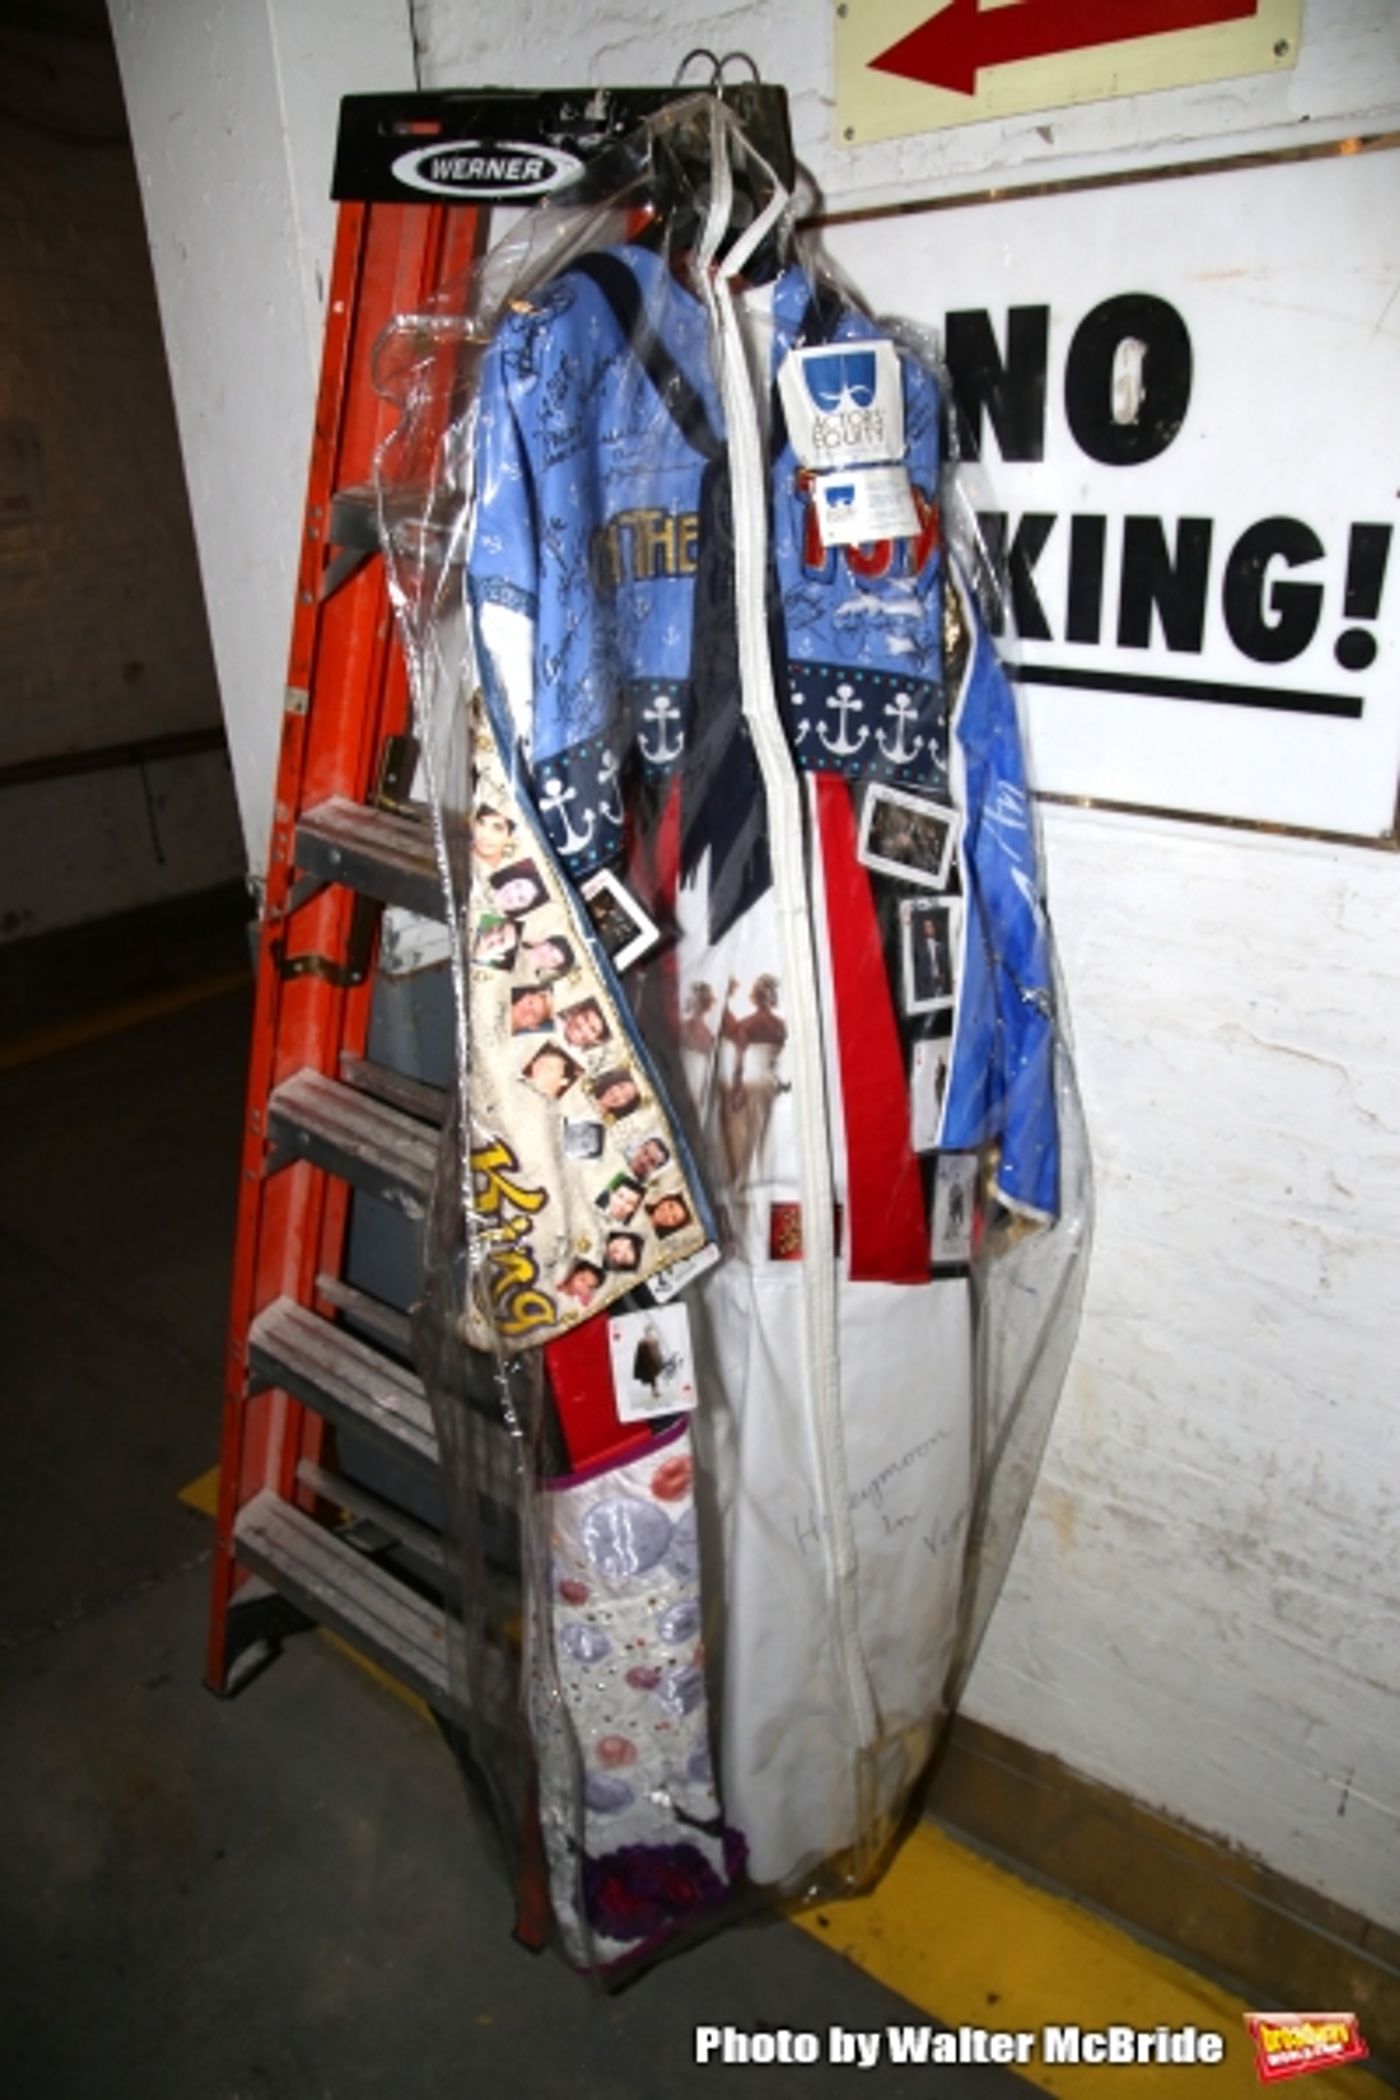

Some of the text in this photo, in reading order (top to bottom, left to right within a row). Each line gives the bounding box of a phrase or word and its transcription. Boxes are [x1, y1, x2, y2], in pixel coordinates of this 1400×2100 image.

[429, 157, 545, 181] WERNER
[943, 291, 1194, 467] NO
[974, 511, 1394, 672] KING!
